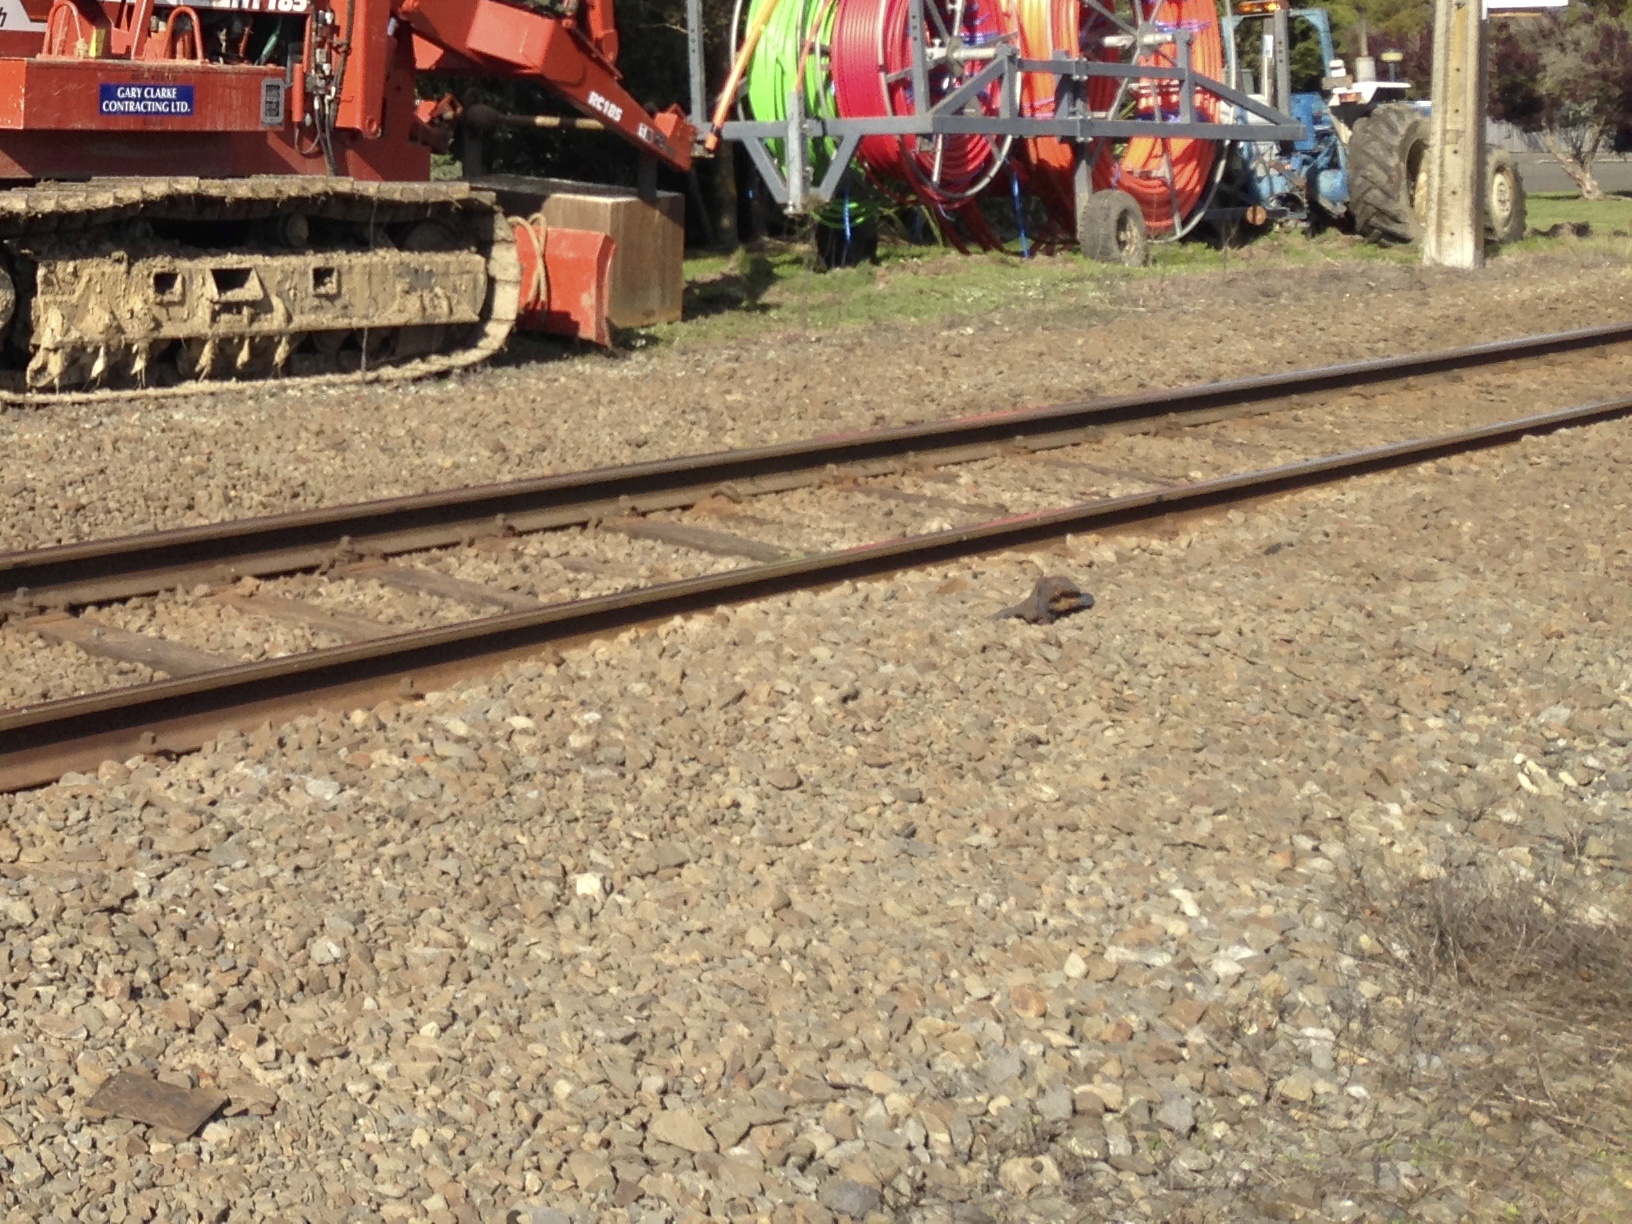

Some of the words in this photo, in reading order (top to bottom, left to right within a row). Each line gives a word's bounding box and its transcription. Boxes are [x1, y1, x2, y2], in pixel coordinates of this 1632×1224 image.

[117, 87, 143, 99] GARY
[144, 87, 177, 99] CLARKE
[102, 100, 169, 113] CONTRACTING
[171, 101, 191, 113] LTD.
[588, 91, 623, 122] RC185
